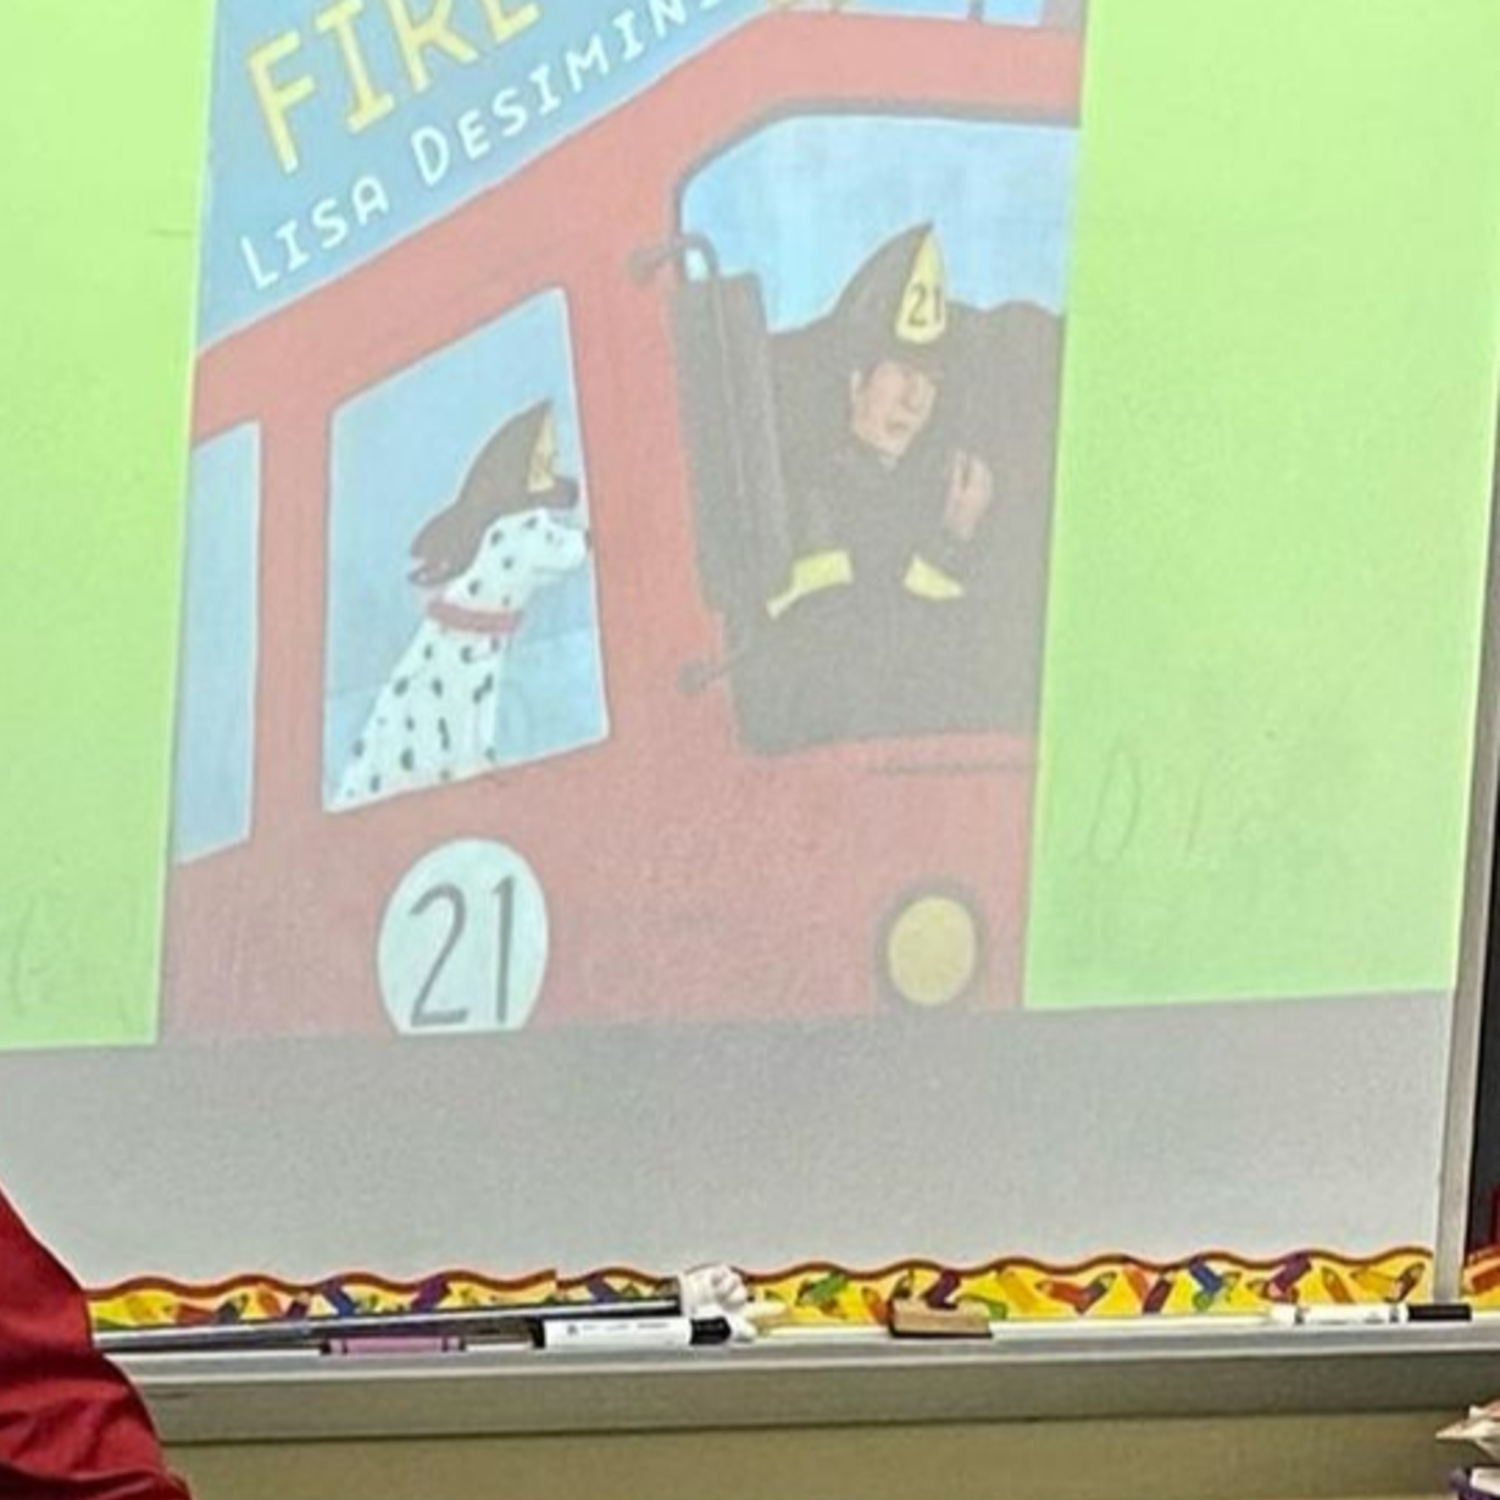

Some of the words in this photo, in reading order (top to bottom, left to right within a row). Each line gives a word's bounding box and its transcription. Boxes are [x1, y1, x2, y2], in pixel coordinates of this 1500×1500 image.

[240, 175, 390, 290] LISA
[410, 0, 724, 187] DESIMIN
[907, 283, 943, 329] 21
[409, 873, 518, 1028] 21
